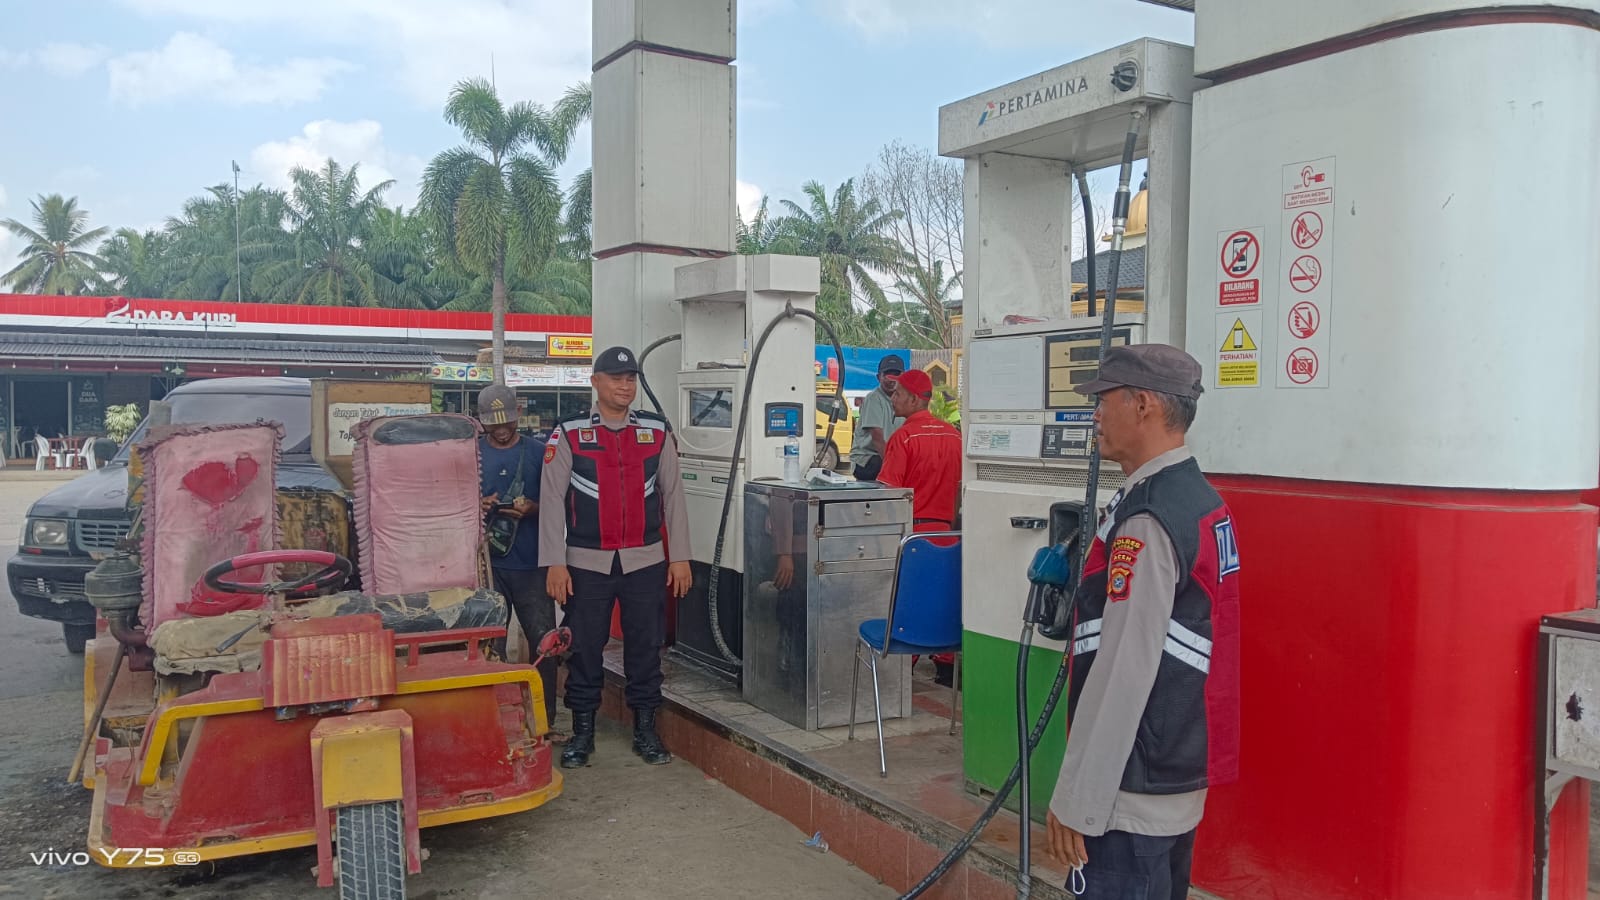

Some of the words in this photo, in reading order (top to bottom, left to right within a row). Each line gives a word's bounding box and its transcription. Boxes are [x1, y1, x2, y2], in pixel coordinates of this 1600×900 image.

[999, 77, 1088, 116] PERTAMINA
[1224, 281, 1255, 292] DILARANG
[133, 309, 186, 325] DARA
[333, 408, 359, 421] Jangan
[1113, 554, 1132, 562] ACEH
